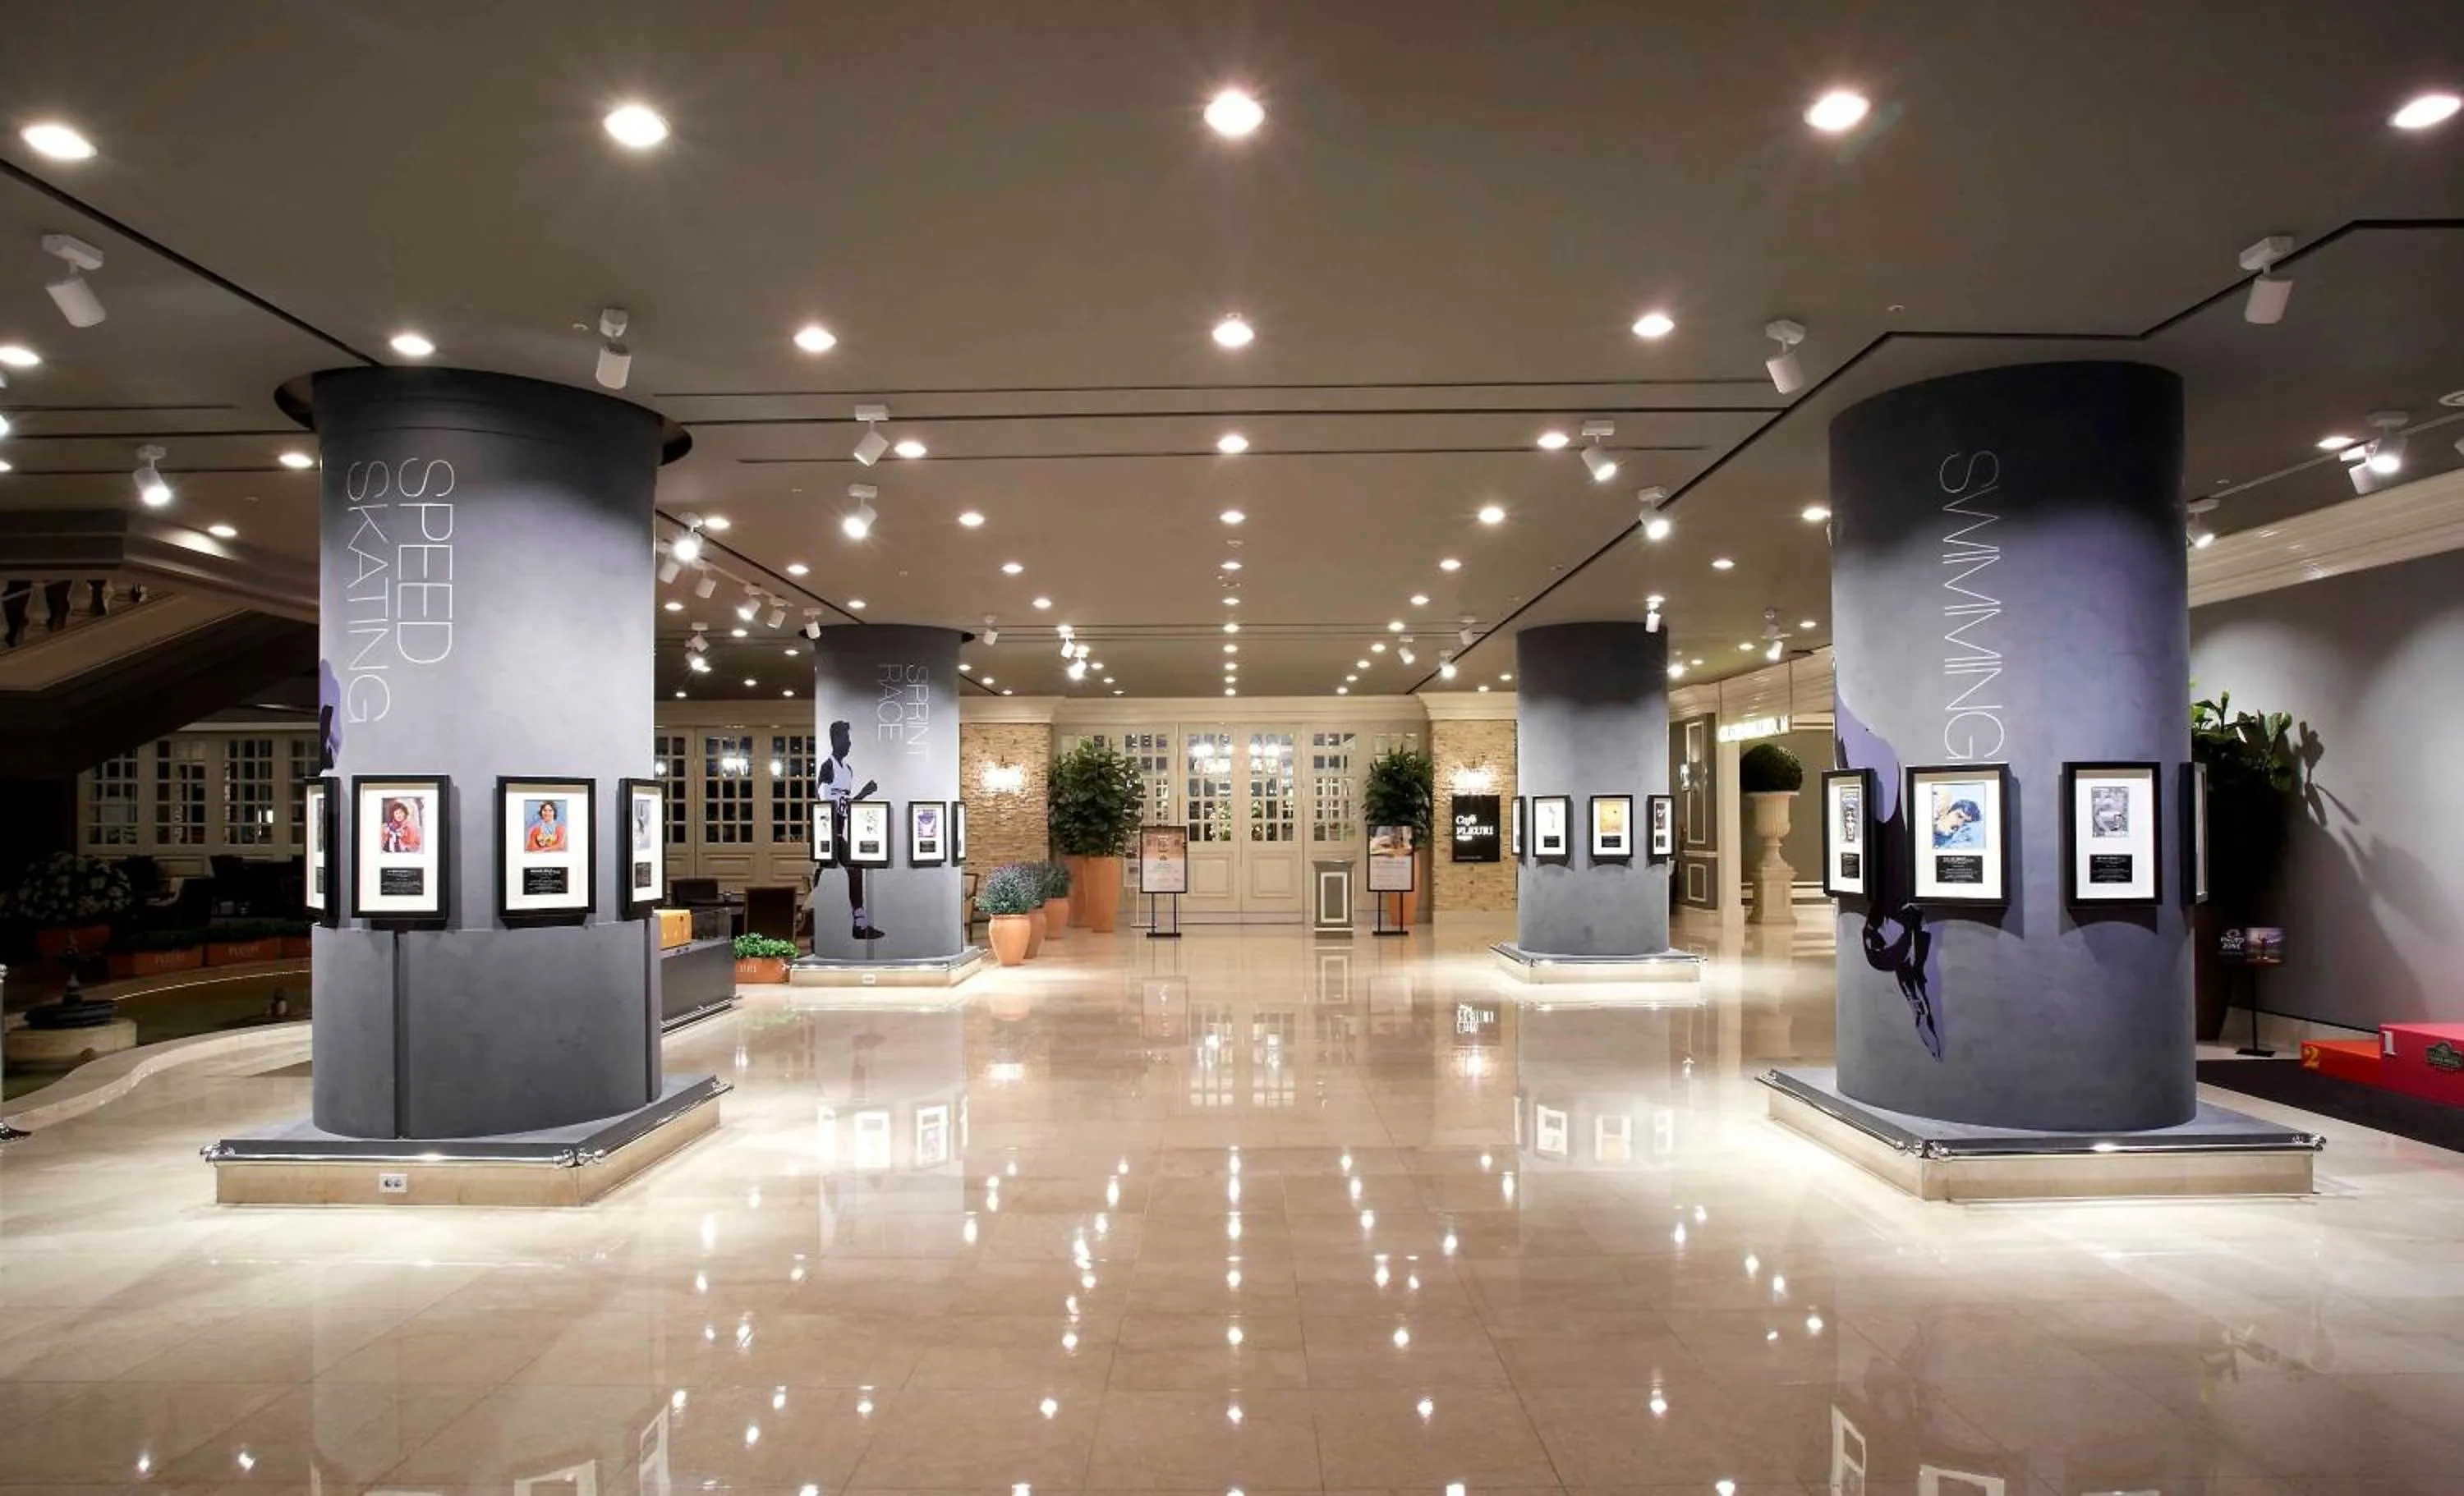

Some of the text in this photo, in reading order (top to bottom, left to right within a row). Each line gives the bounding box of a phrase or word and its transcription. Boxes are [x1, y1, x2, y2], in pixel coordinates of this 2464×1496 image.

[347, 460, 391, 724] SKATING
[398, 457, 455, 665] SPEED
[1939, 450, 2005, 760] SWIMMING
[876, 663, 903, 741] RACE
[905, 663, 930, 763] SPRINT
[2303, 1045, 2320, 1068] 2
[2383, 1030, 2397, 1056] 1
